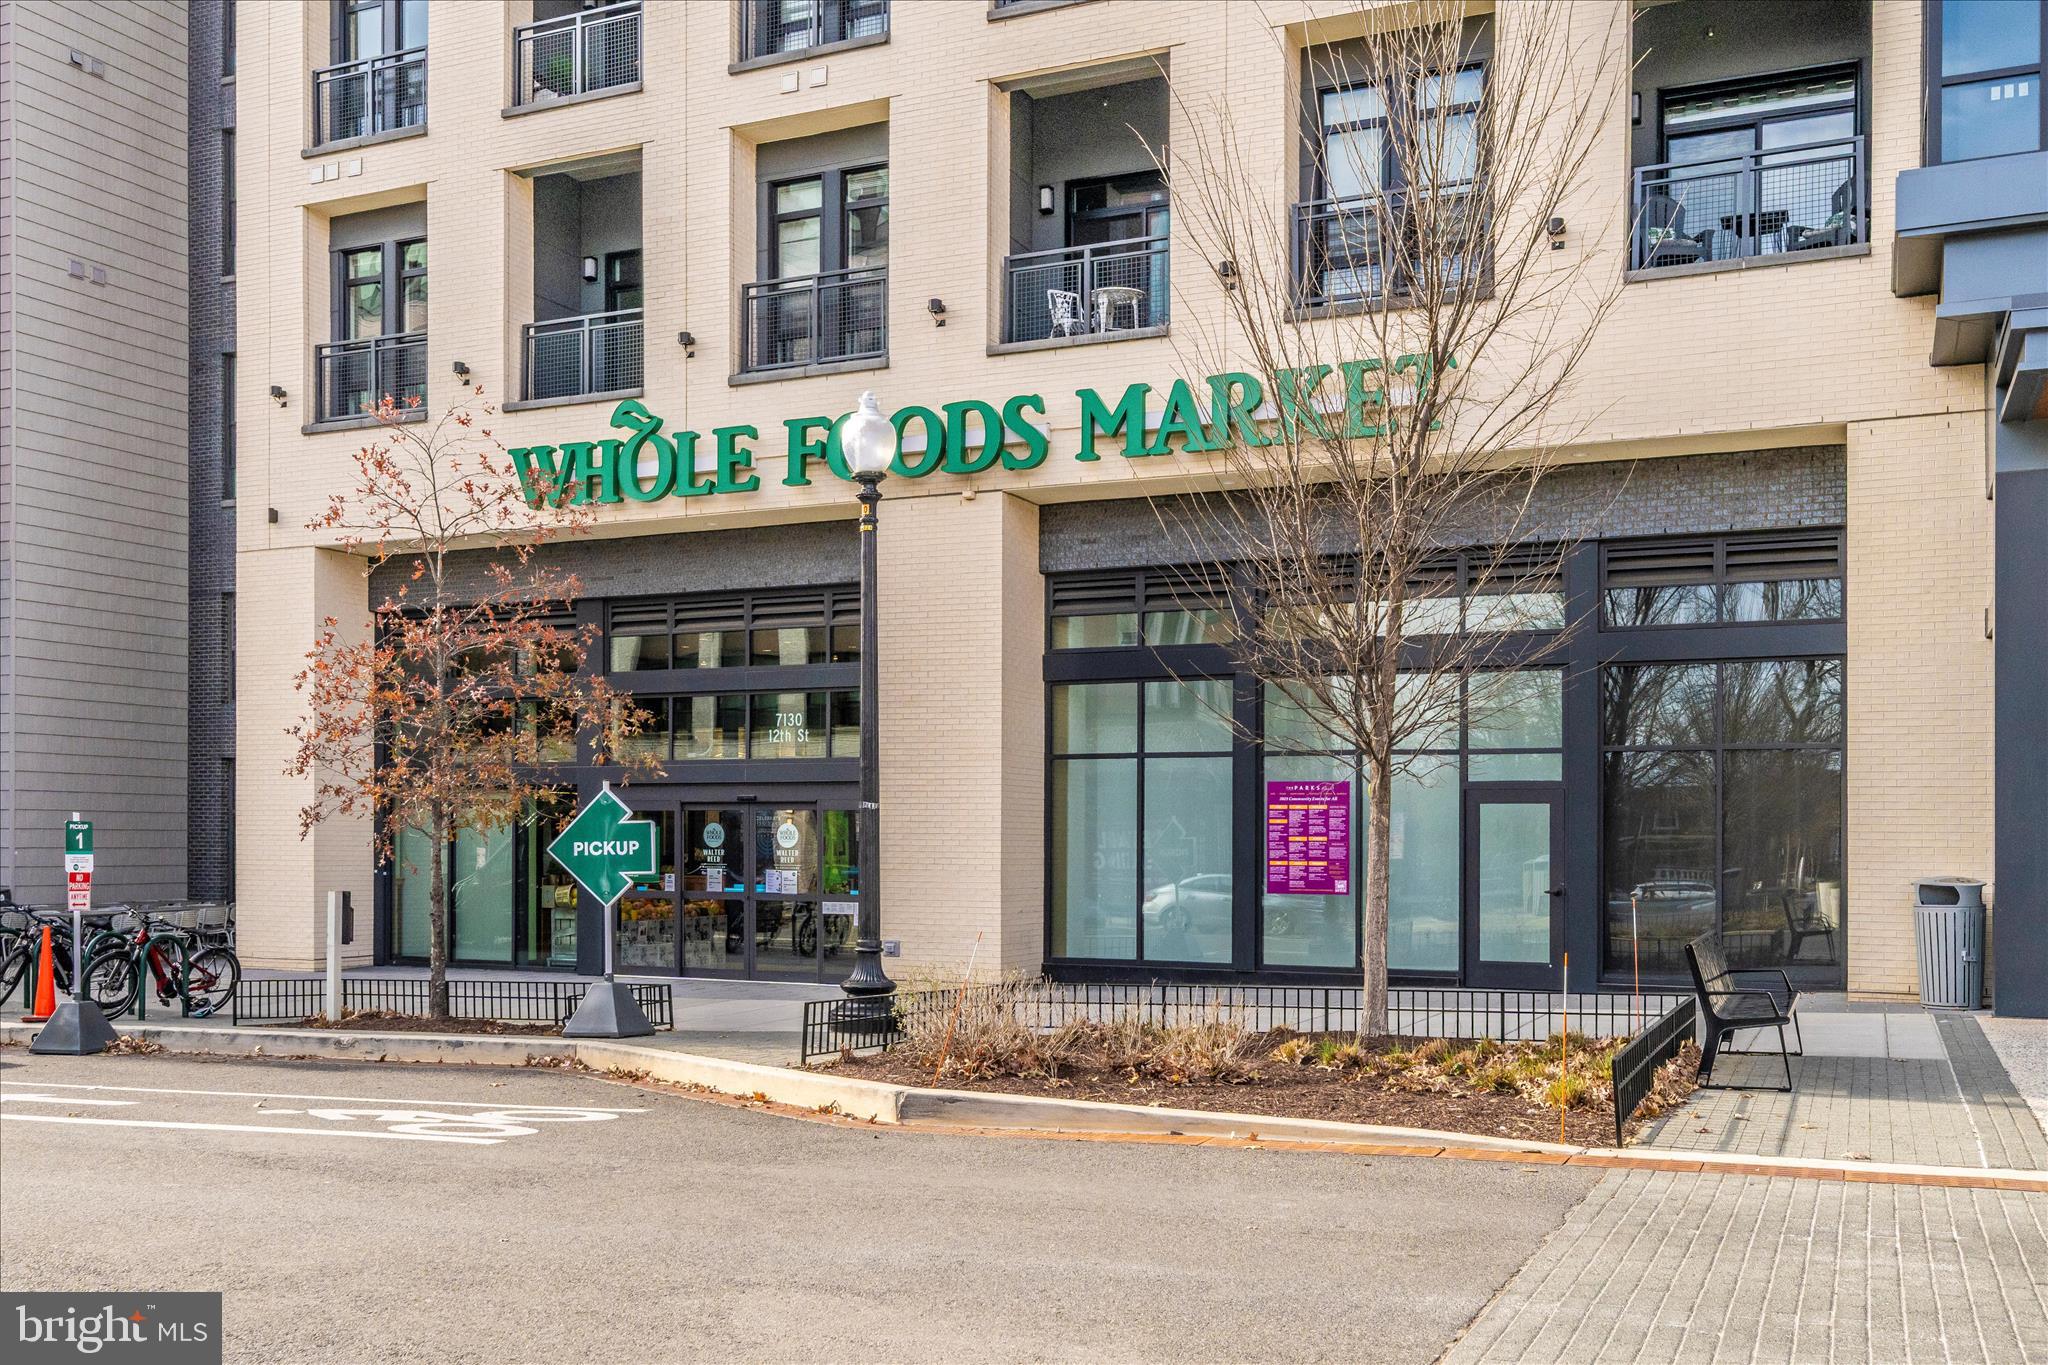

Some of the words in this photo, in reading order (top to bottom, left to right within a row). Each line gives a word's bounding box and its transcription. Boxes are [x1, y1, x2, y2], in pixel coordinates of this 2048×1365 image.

[508, 400, 760, 509] WHOLE
[1075, 352, 1457, 462] MARKET
[776, 713, 802, 727] 7130
[768, 729, 791, 743] 12th
[797, 729, 809, 742] St
[76, 832, 83, 849] 1
[573, 840, 640, 856] PICKUP
[702, 848, 725, 856] WALTER
[776, 849, 799, 857] WALTER
[780, 856, 795, 864] REED
[76, 874, 84, 882] NO
[69, 882, 90, 891] PARKING
